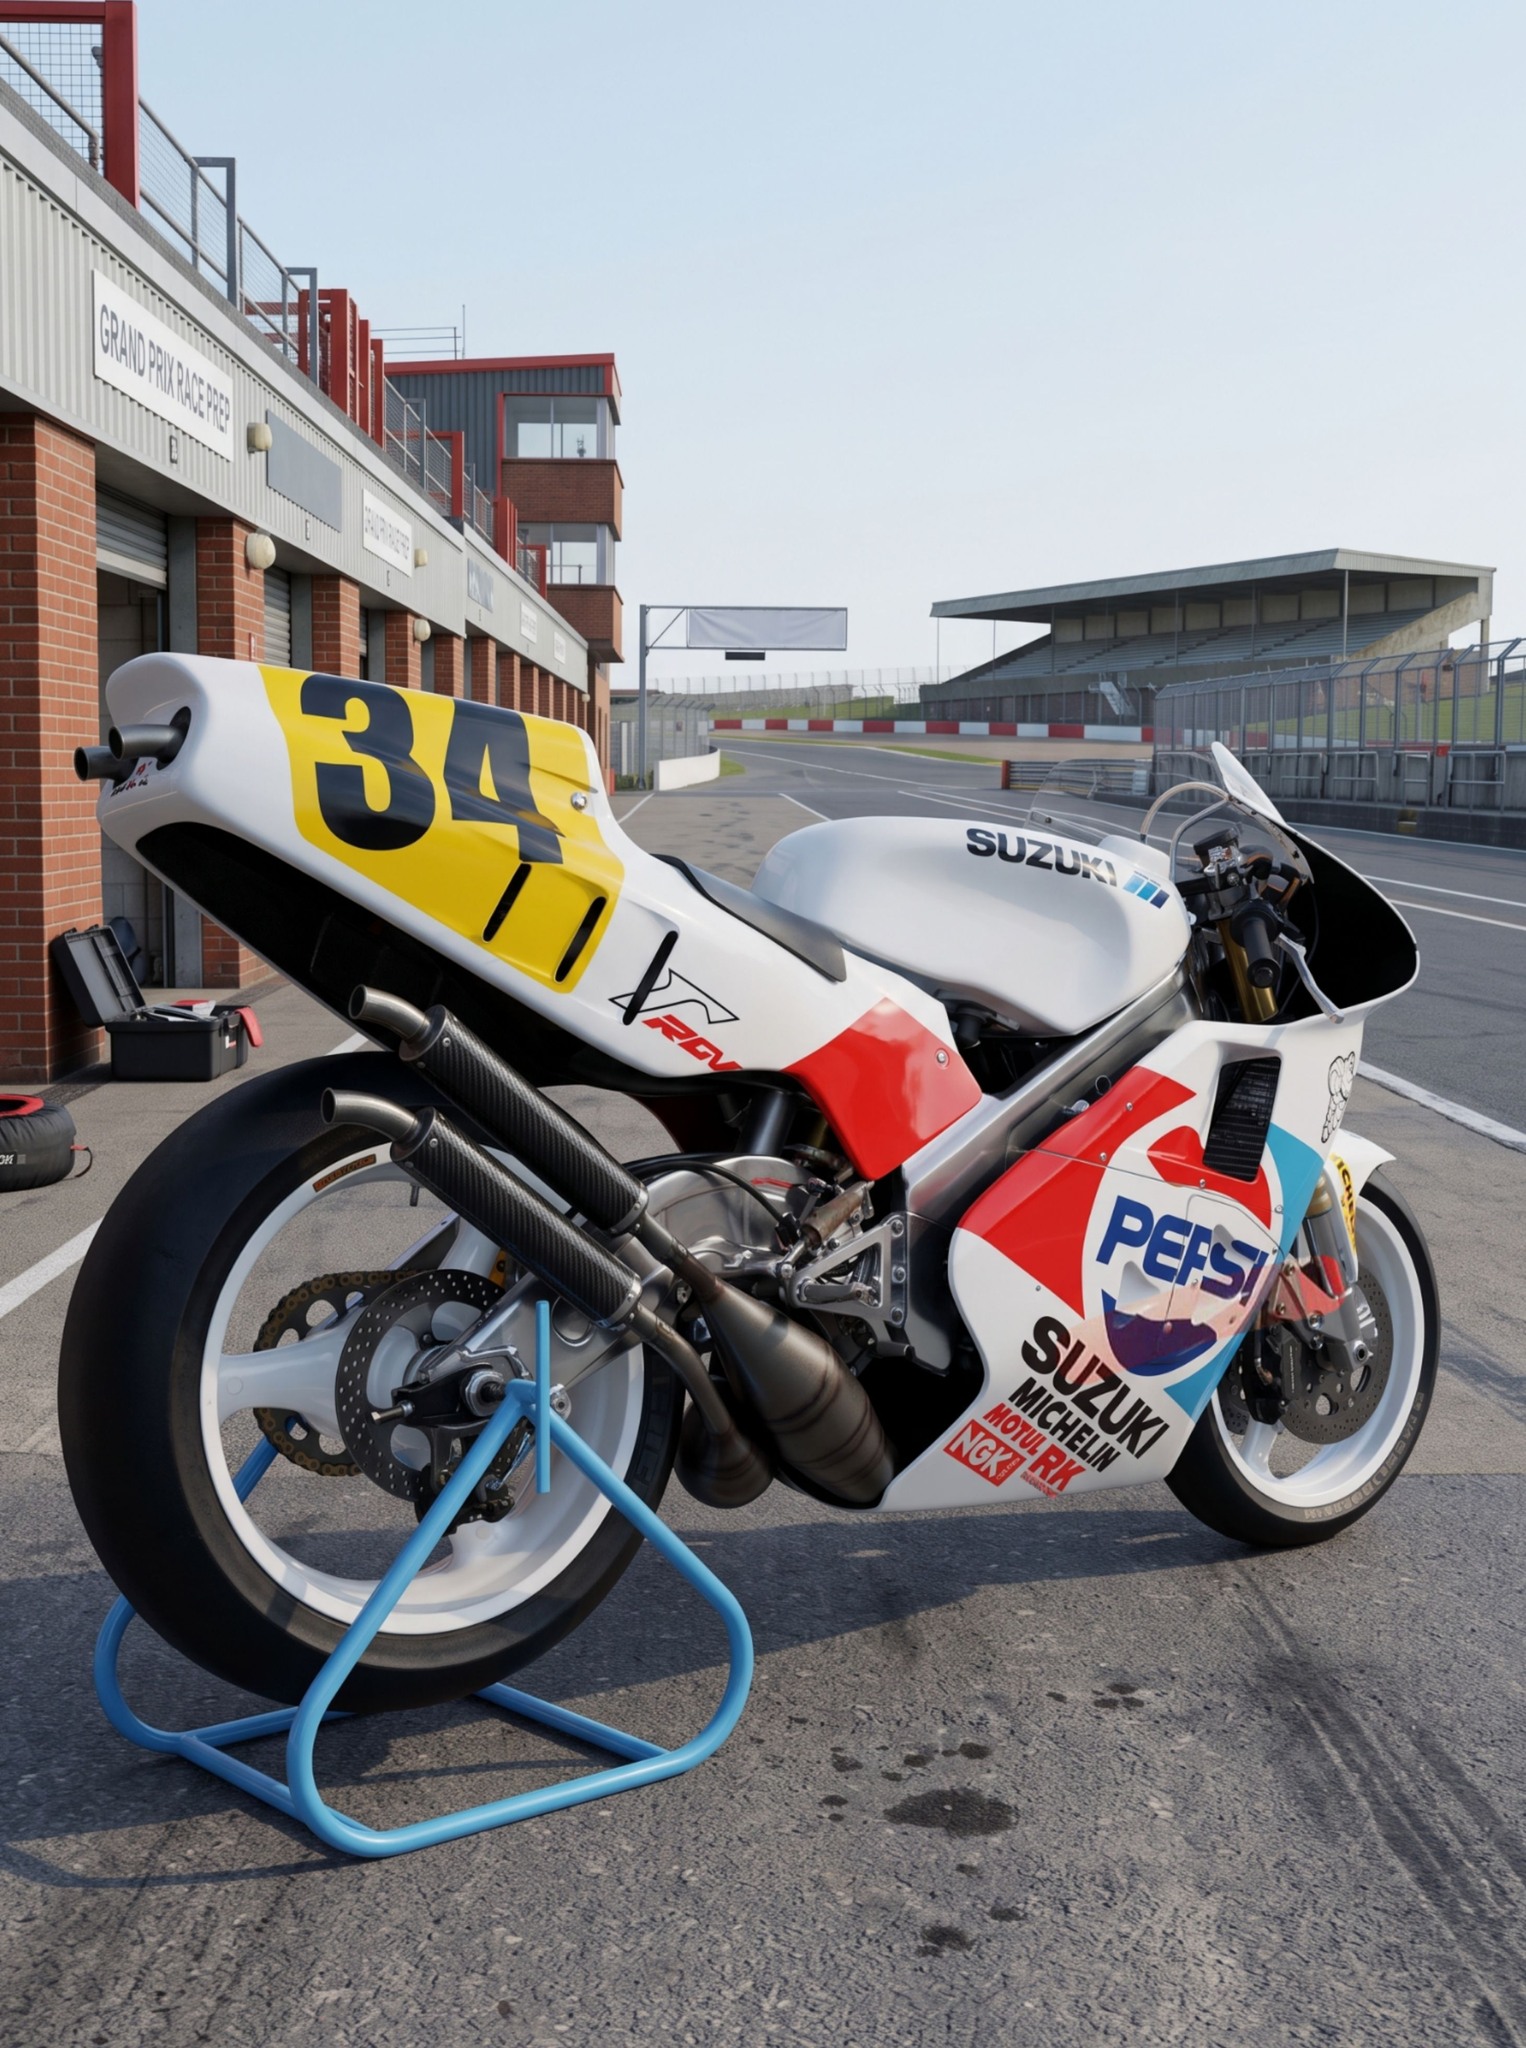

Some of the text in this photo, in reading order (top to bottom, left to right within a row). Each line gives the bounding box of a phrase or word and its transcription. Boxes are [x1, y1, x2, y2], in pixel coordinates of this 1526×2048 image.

[100, 304, 230, 434] GRAND PRIX RACE PREP
[300, 674, 565, 864] 34
[966, 828, 1118, 887] SUZUKI
[641, 1013, 744, 1072] RGV
[1096, 1195, 1270, 1307] PEPSI
[1008, 1376, 1121, 1473] MICHELIN
[1021, 1315, 1170, 1460] SUZUKI
[949, 1423, 1014, 1478] NGK
[982, 1402, 1047, 1456] MOTUL
[1027, 1443, 1086, 1492] RK
